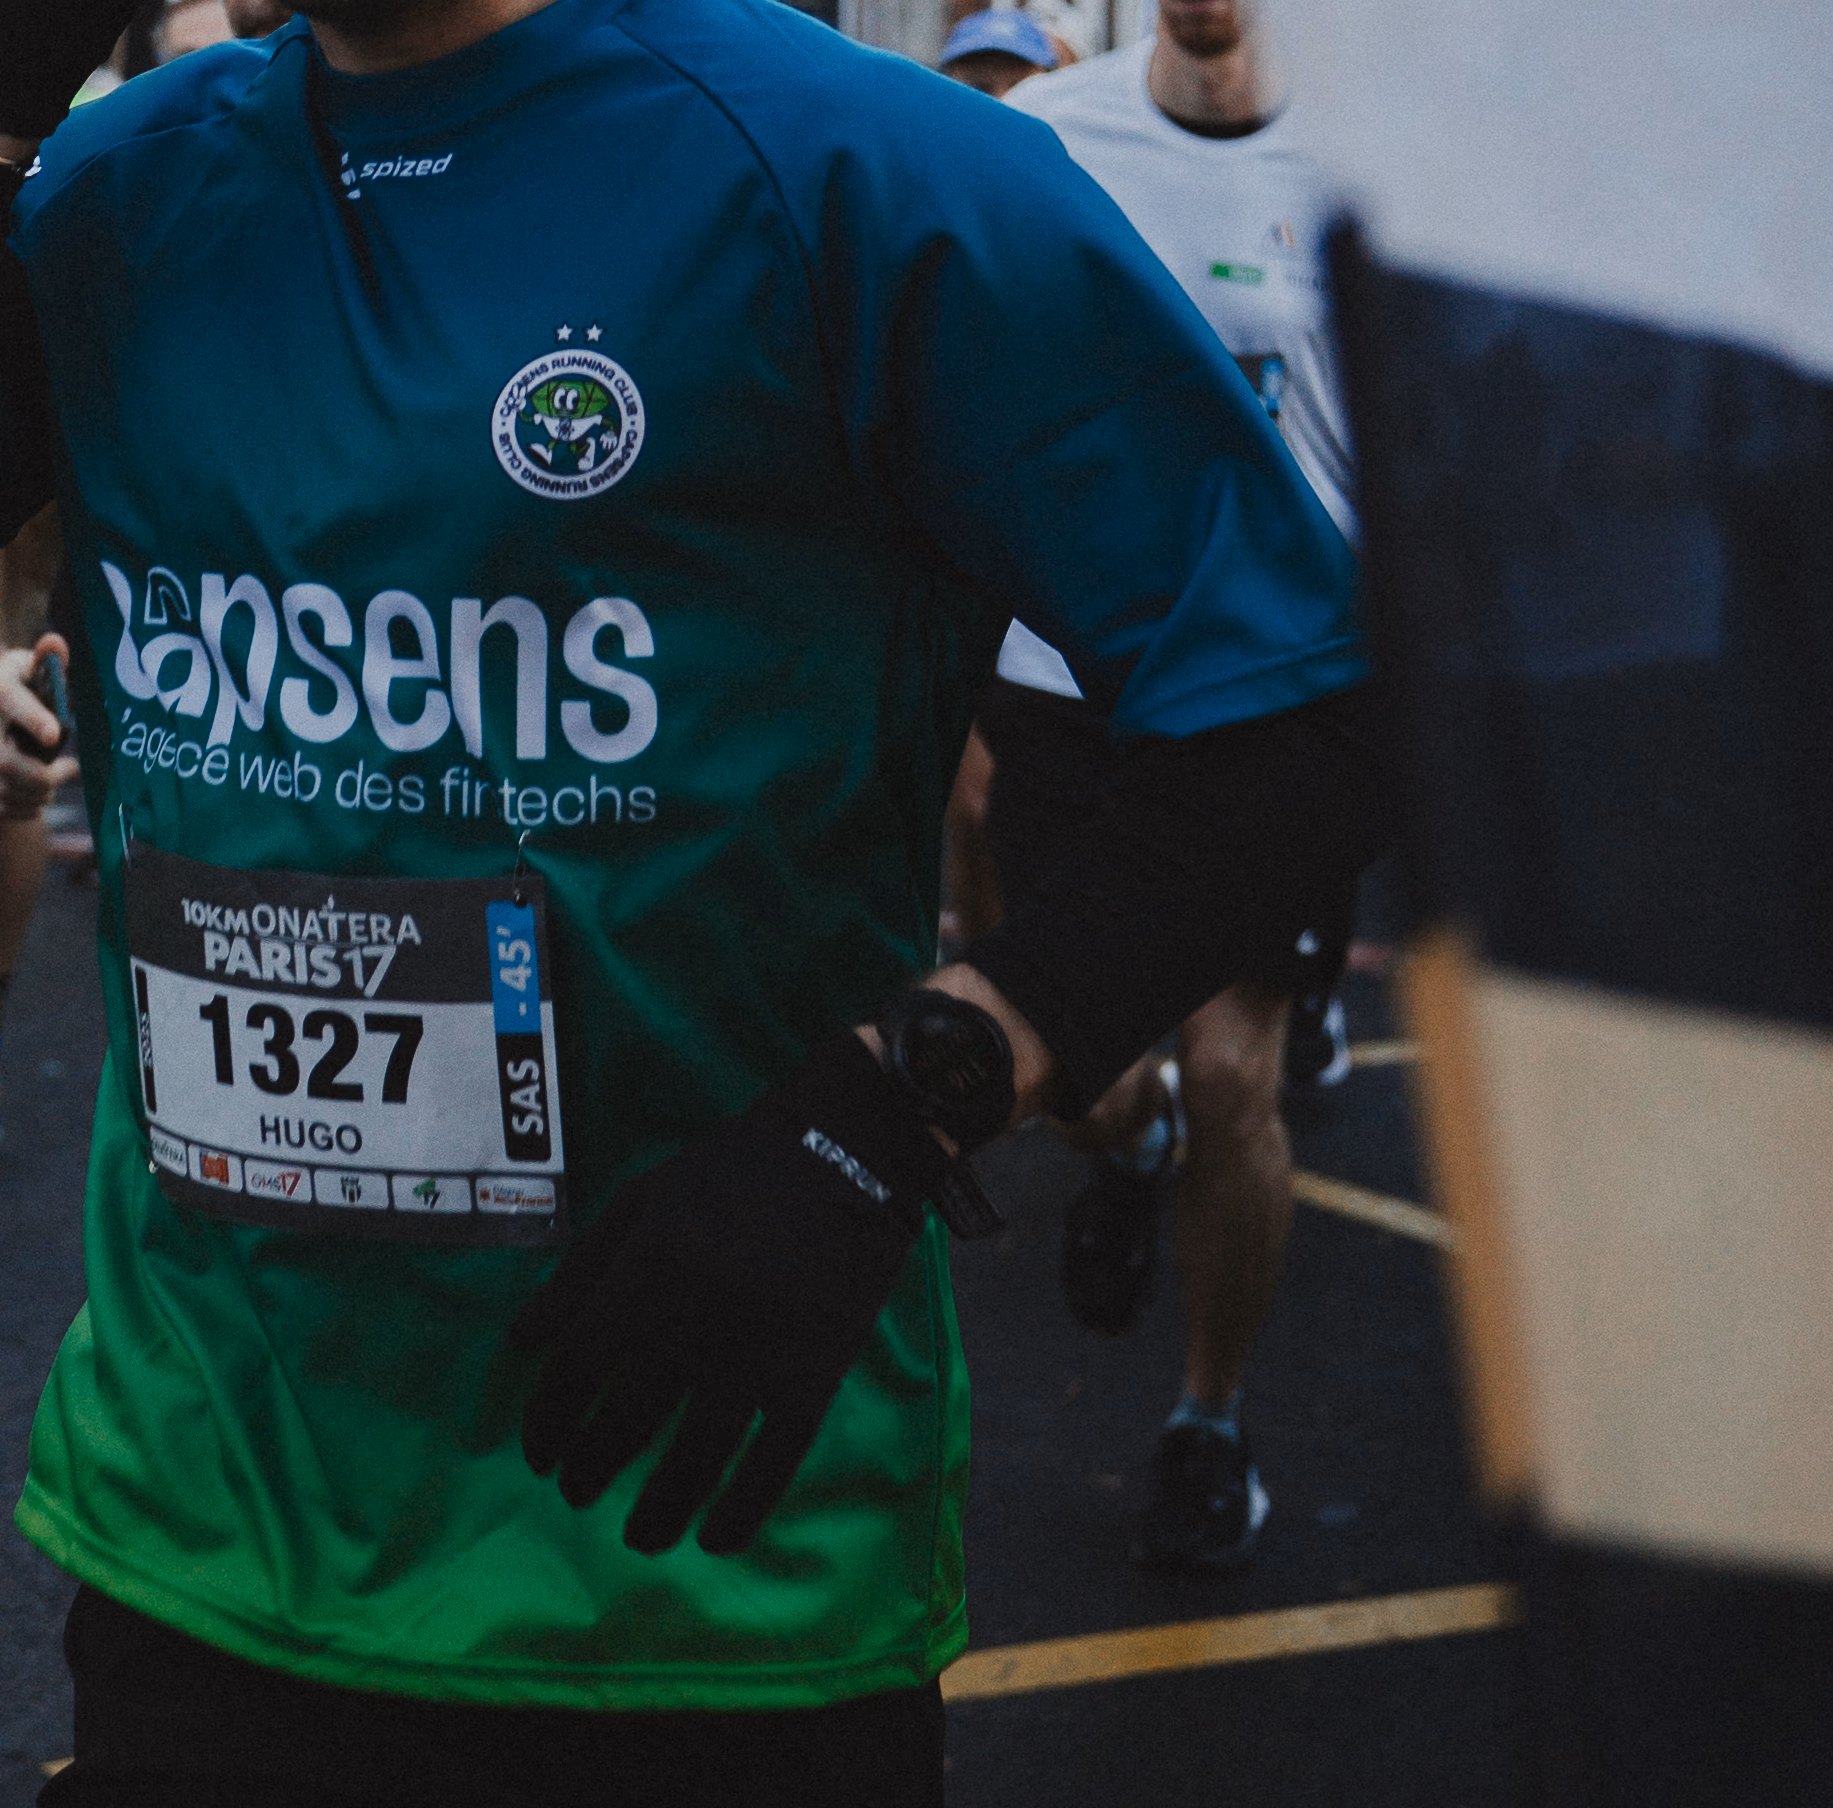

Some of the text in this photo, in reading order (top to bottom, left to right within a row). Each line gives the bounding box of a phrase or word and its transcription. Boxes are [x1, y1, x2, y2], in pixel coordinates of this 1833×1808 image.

[359, 152, 454, 180] spized
[551, 355, 617, 382] RUNNING
[613, 378, 639, 417] CLUB
[238, 749, 322, 802] web
[335, 759, 426, 812] des
[198, 993, 425, 1106] 1327
[506, 1058, 545, 1137] SAS
[258, 1113, 364, 1155] HUGO
